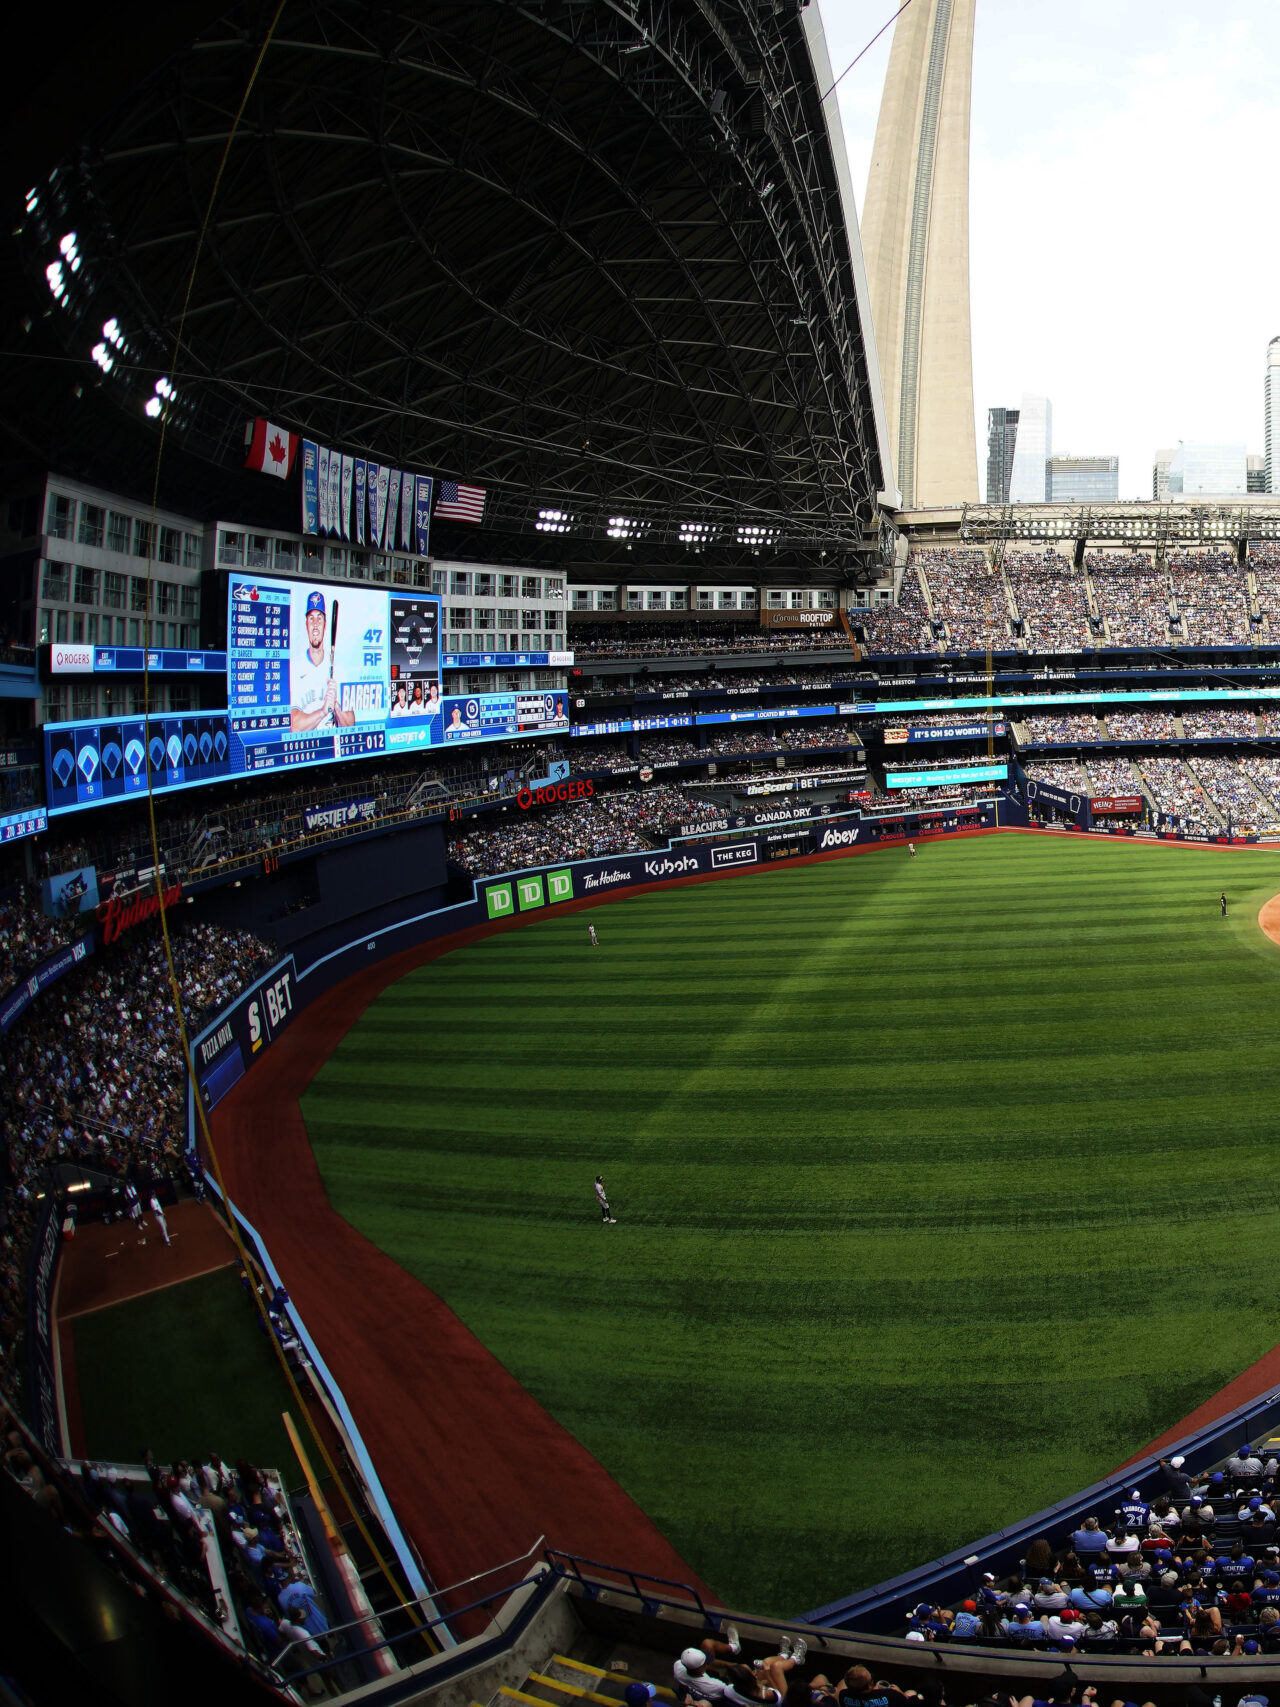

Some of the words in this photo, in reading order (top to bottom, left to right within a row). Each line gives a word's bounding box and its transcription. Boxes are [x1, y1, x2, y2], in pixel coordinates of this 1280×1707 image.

[417, 510, 429, 530] 32
[773, 614, 799, 623] Corona
[800, 613, 834, 623] ROOFTOP
[363, 629, 383, 643] 47
[64, 654, 90, 664] ROGERS
[363, 653, 383, 666] RF
[341, 682, 384, 711] BARGER
[389, 732, 419, 744] WESTJET
[914, 730, 929, 738] IT'S
[931, 730, 942, 738] OH
[944, 729, 954, 737] SO
[955, 728, 980, 736] WORTH
[87, 786, 94, 794] 1B
[133, 777, 140, 785] 1B
[747, 781, 793, 796] theScore
[800, 778, 819, 789] BET
[536, 779, 594, 805] ROGERS
[1093, 799, 1114, 809] HEINZ
[306, 807, 348, 829] WESTJET
[358, 801, 376, 812] FLIGHT
[754, 810, 792, 823] CANADA
[767, 833, 782, 842] Active
[821, 828, 859, 848] Sobeys
[717, 853, 733, 861] THE
[736, 850, 752, 859] KEG
[645, 857, 699, 876] Kubota
[550, 875, 570, 896] TD
[583, 874, 599, 889] Tim
[599, 869, 631, 886] Hortons
[489, 889, 510, 911] TD
[520, 882, 541, 903] TD
[72, 942, 86, 961] VISA
[27, 976, 39, 997] VISA
[248, 1001, 261, 1042] S
[266, 972, 292, 1028] BET
[201, 1035, 219, 1063] PIZZA
[217, 1021, 233, 1048] NOVA
[1127, 1514, 1143, 1526] 21
[956, 1622, 971, 1632] 27
